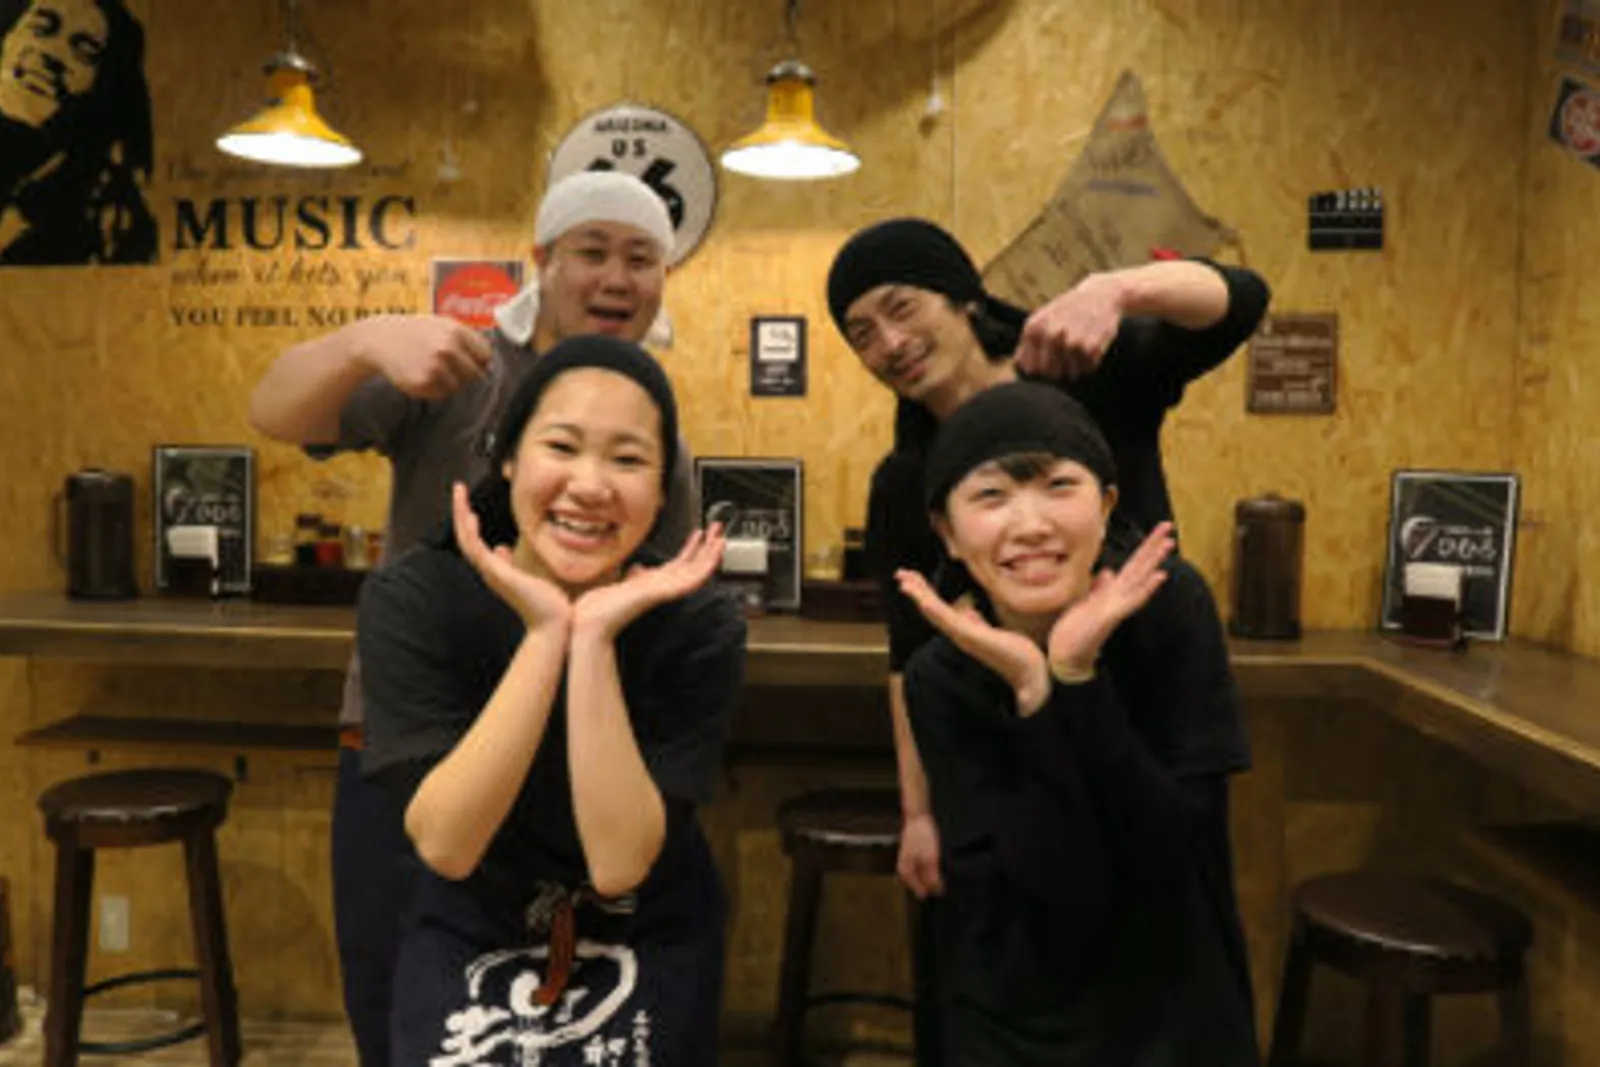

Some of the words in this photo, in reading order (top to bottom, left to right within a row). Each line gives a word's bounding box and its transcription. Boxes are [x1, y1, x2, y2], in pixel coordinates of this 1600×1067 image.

[174, 196, 416, 250] MUSIC
[171, 305, 228, 327] YOU
[236, 305, 300, 327] FEEL
